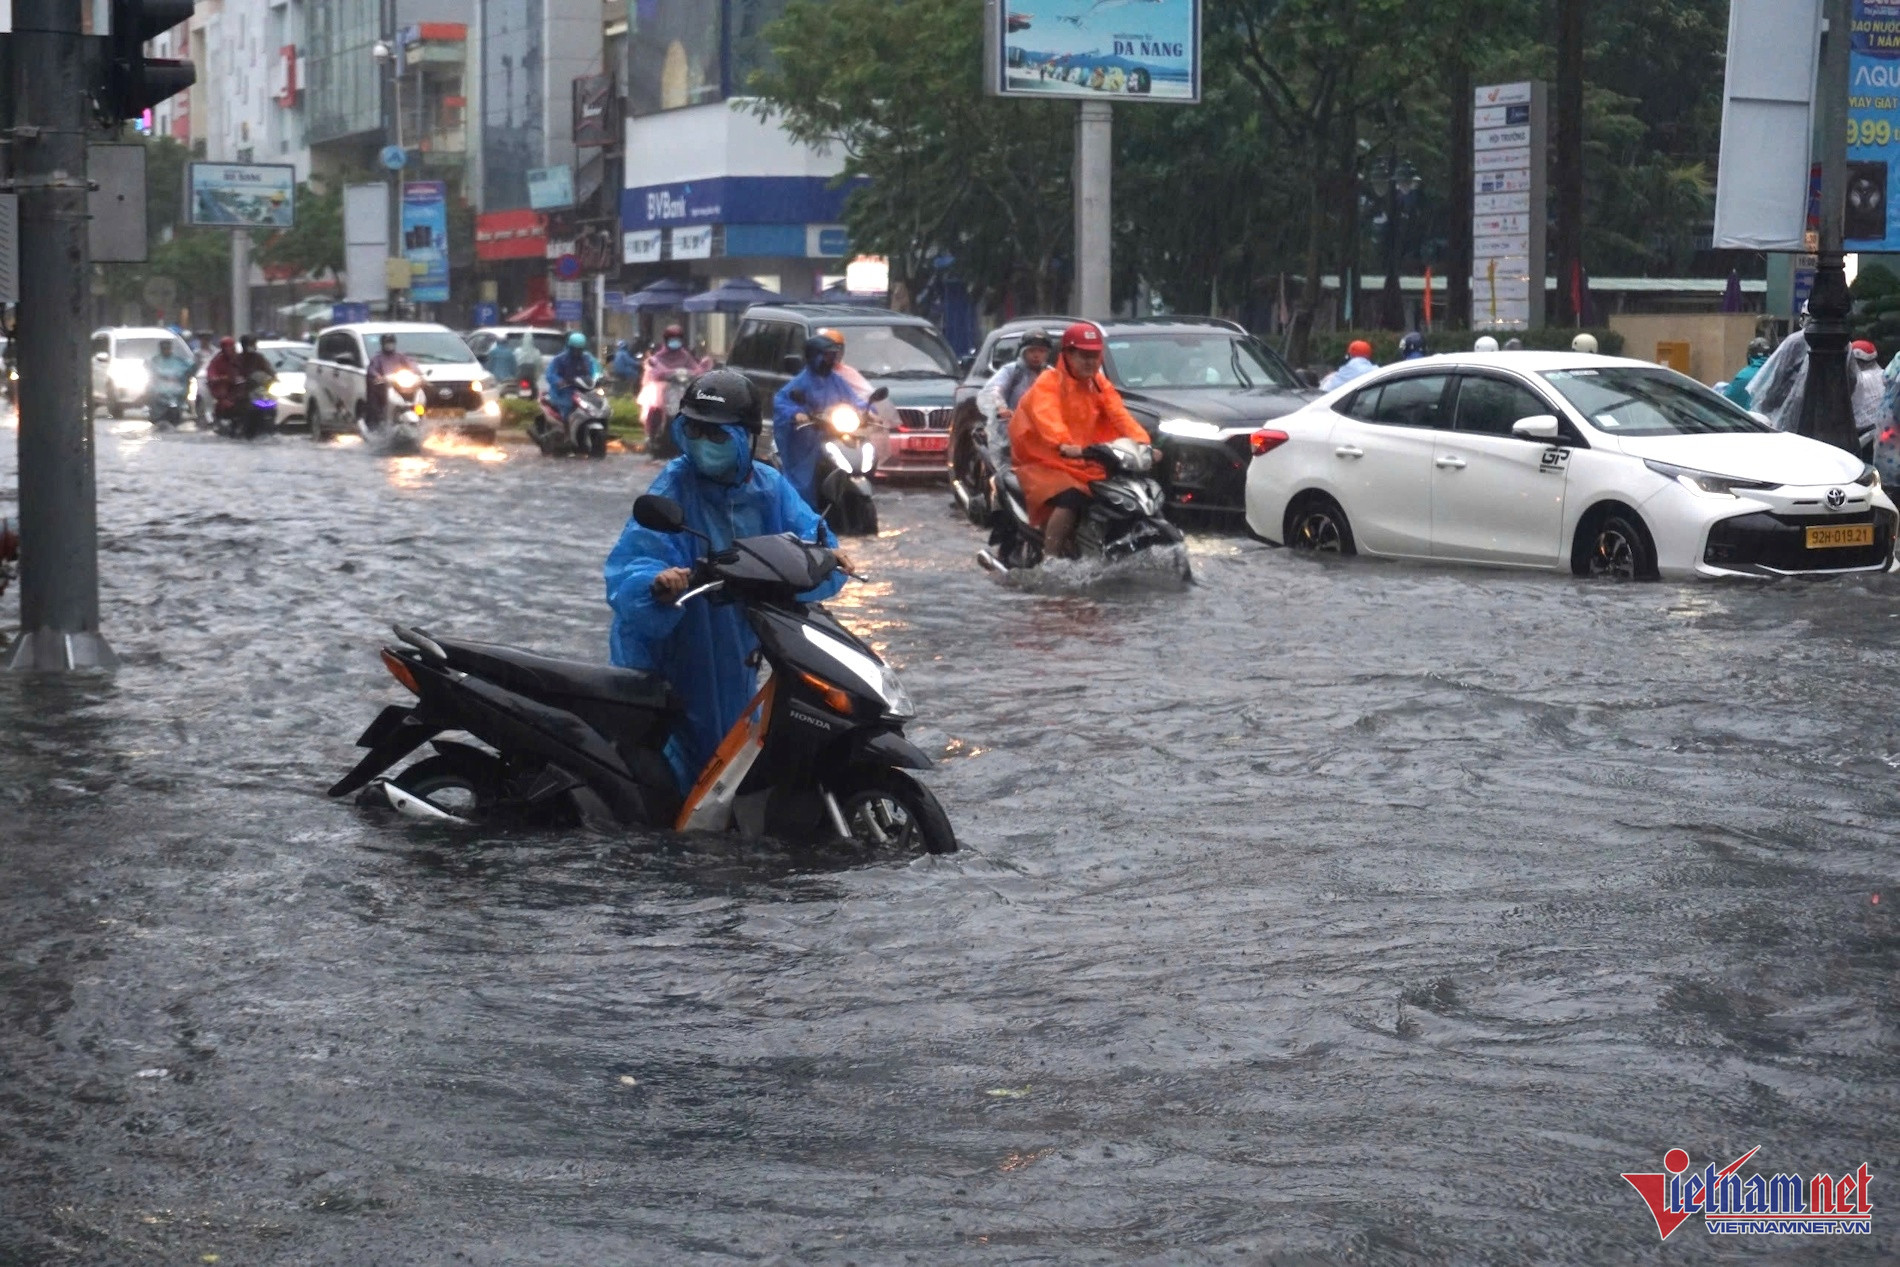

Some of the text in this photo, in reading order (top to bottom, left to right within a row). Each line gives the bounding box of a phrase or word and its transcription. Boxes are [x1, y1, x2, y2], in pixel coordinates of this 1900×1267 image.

[1140, 41, 1183, 57] NANG
[647, 191, 687, 220] BVBank
[790, 710, 831, 730] HONDA
